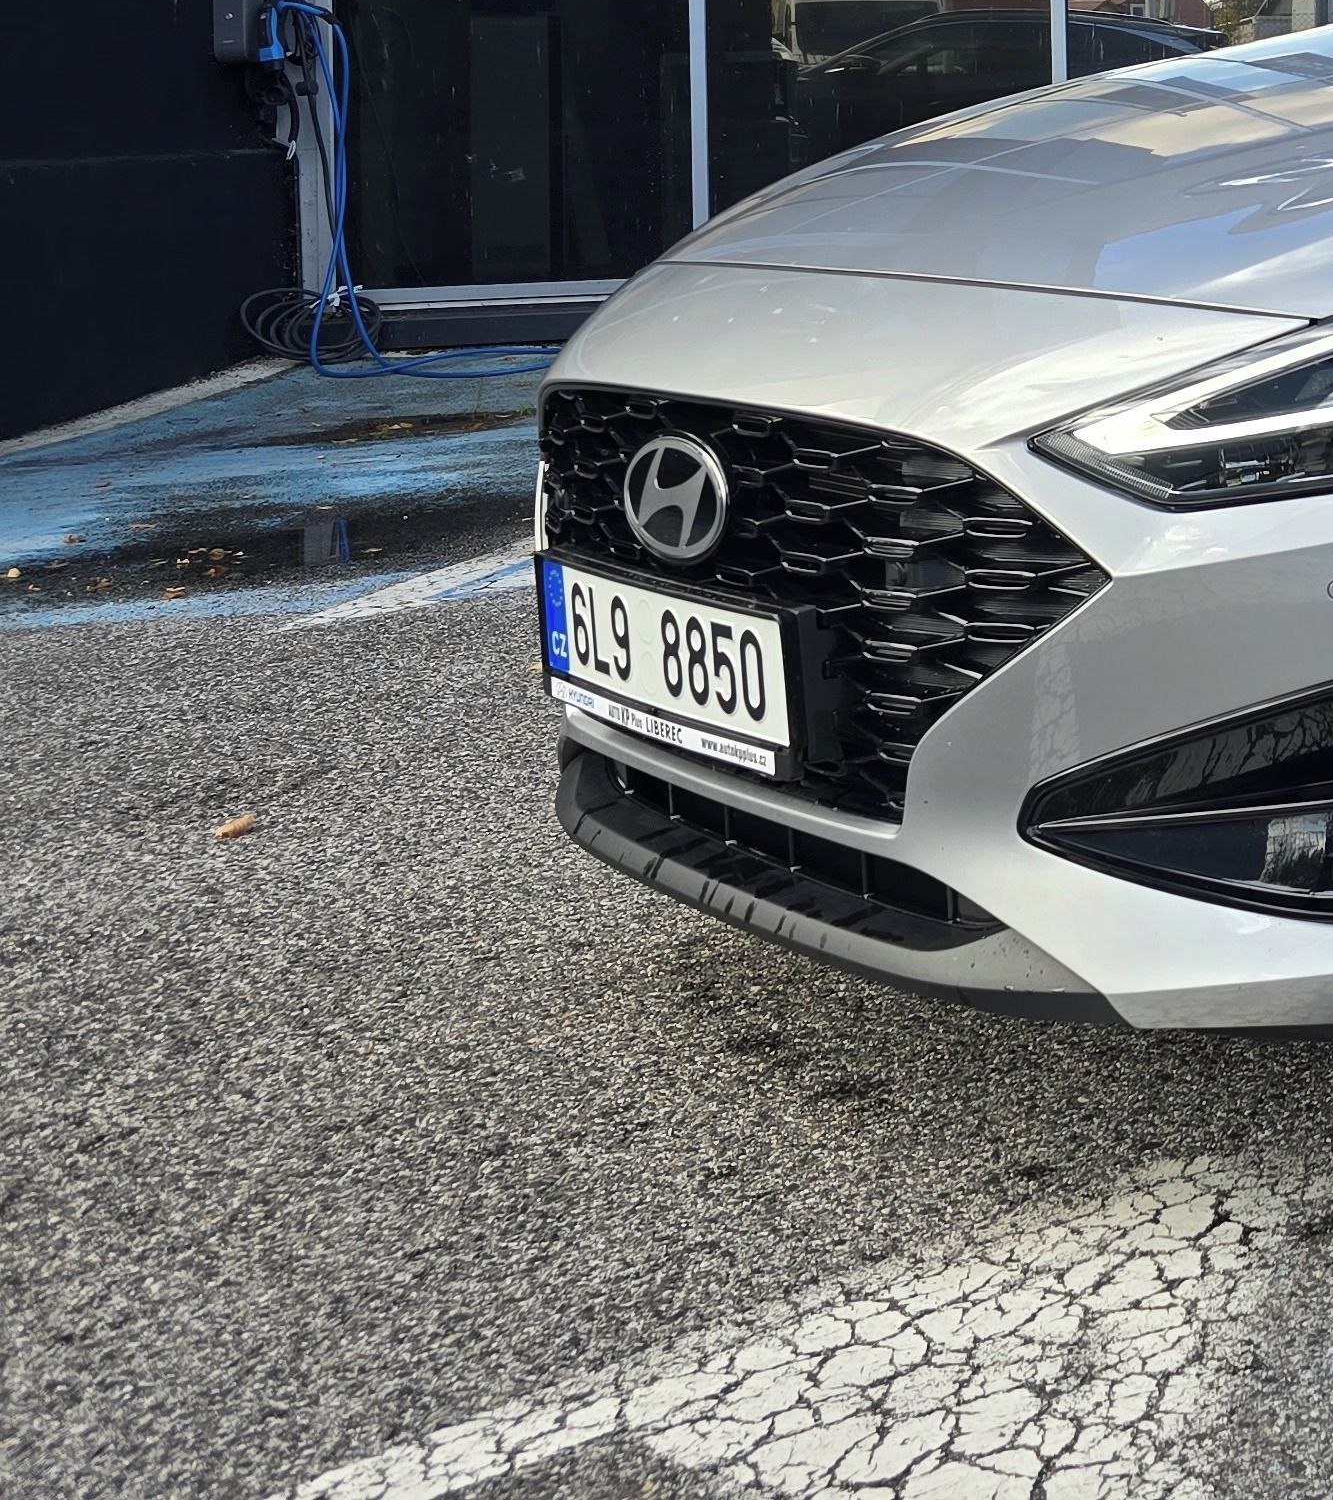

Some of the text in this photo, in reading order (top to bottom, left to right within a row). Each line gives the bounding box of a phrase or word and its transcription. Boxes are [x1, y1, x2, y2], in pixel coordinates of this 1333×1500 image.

[552, 630, 567, 658] CZ
[571, 581, 767, 722] 6L9 8850
[645, 717, 683, 744] LIBEREC
